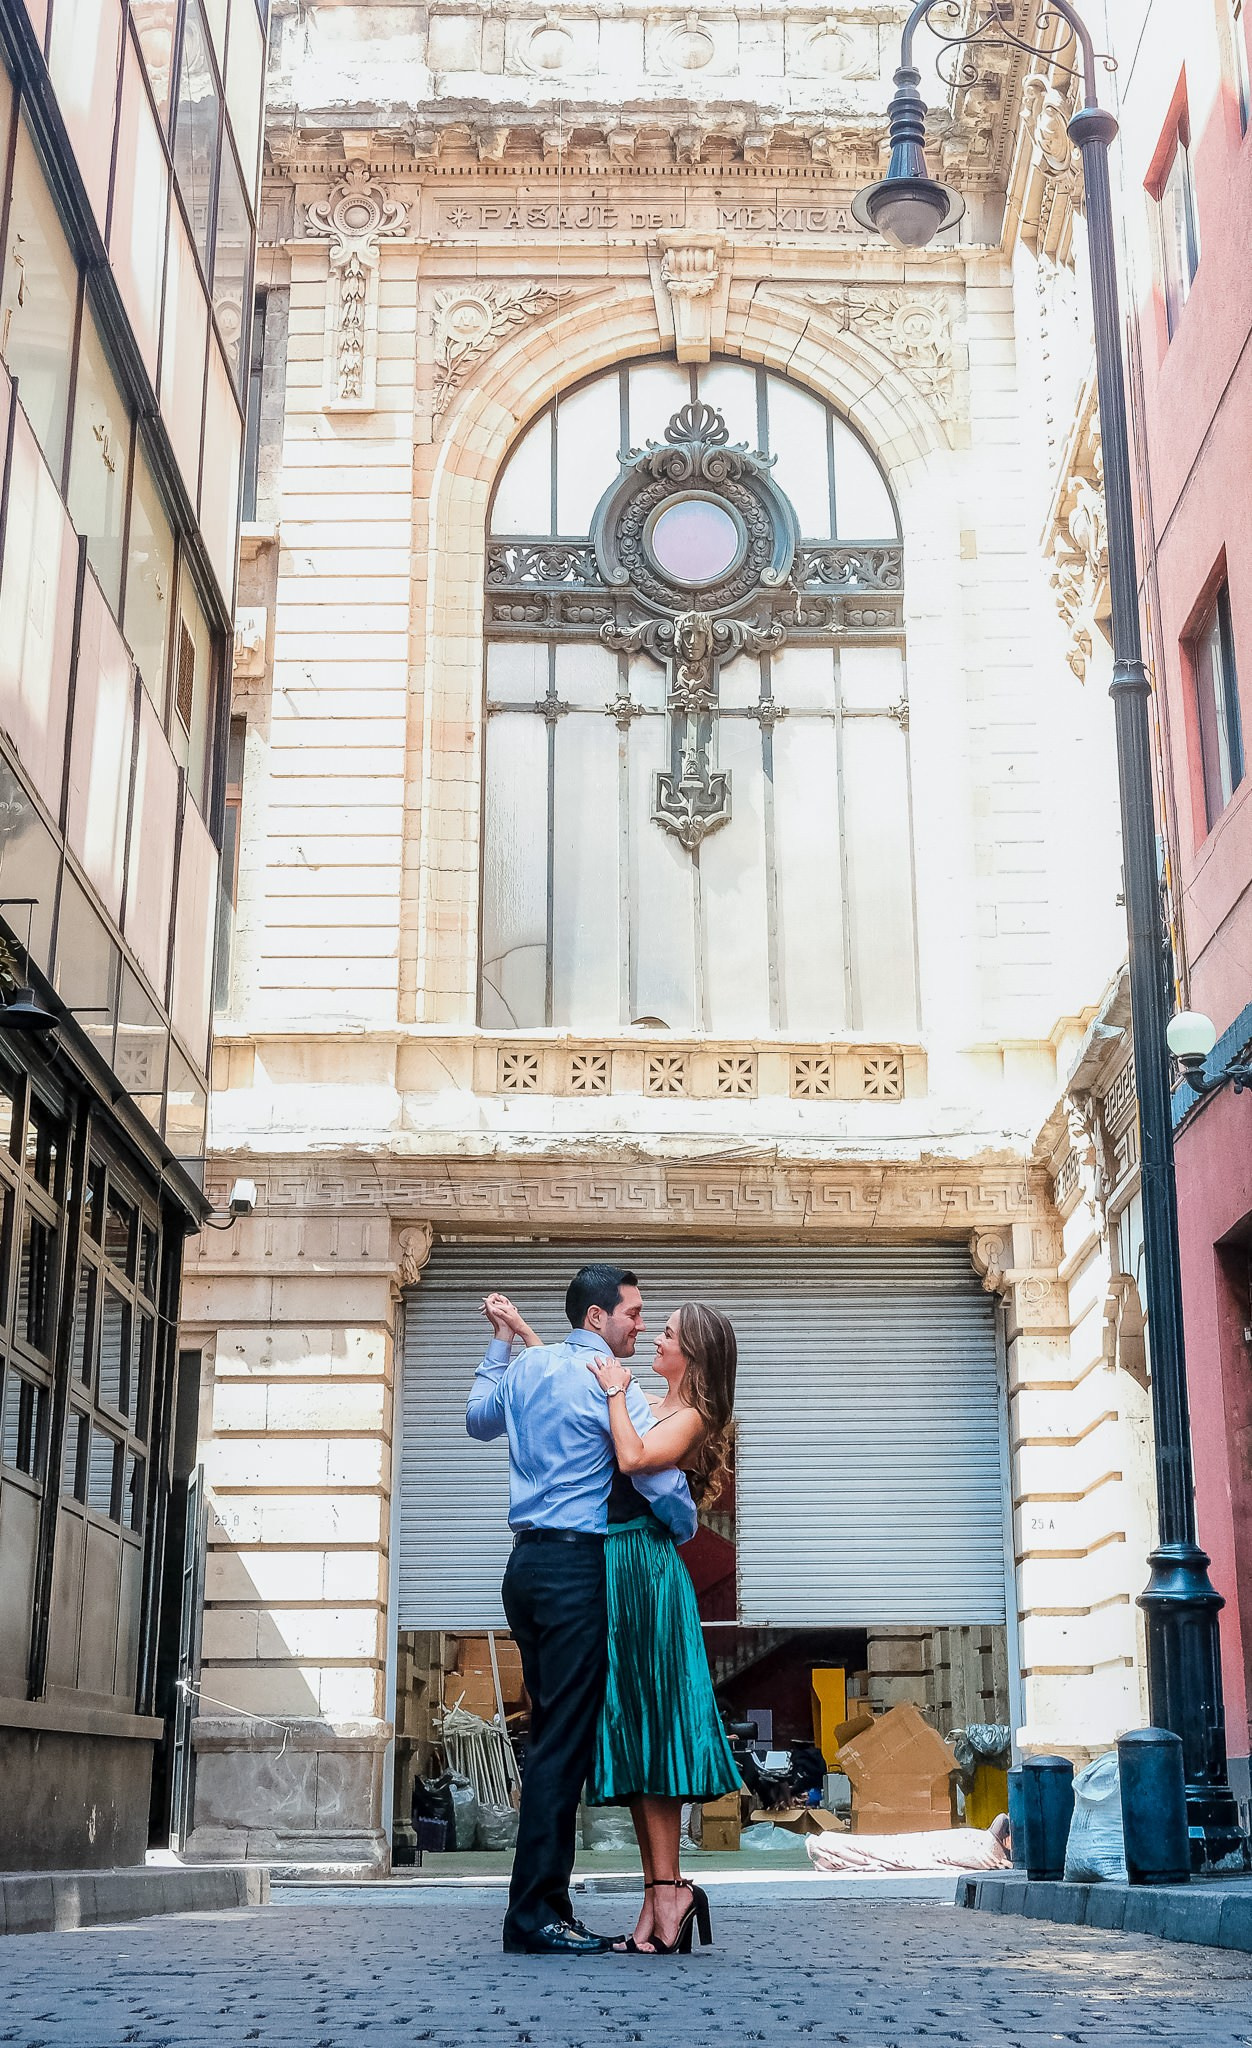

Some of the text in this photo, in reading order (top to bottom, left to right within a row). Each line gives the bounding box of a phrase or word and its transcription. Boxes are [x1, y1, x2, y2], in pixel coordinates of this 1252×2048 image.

[477, 205, 872, 234] PASAJE DEL MEXICA
[214, 1514, 227, 1526] 25
[1031, 1518, 1055, 1530] 25 A
